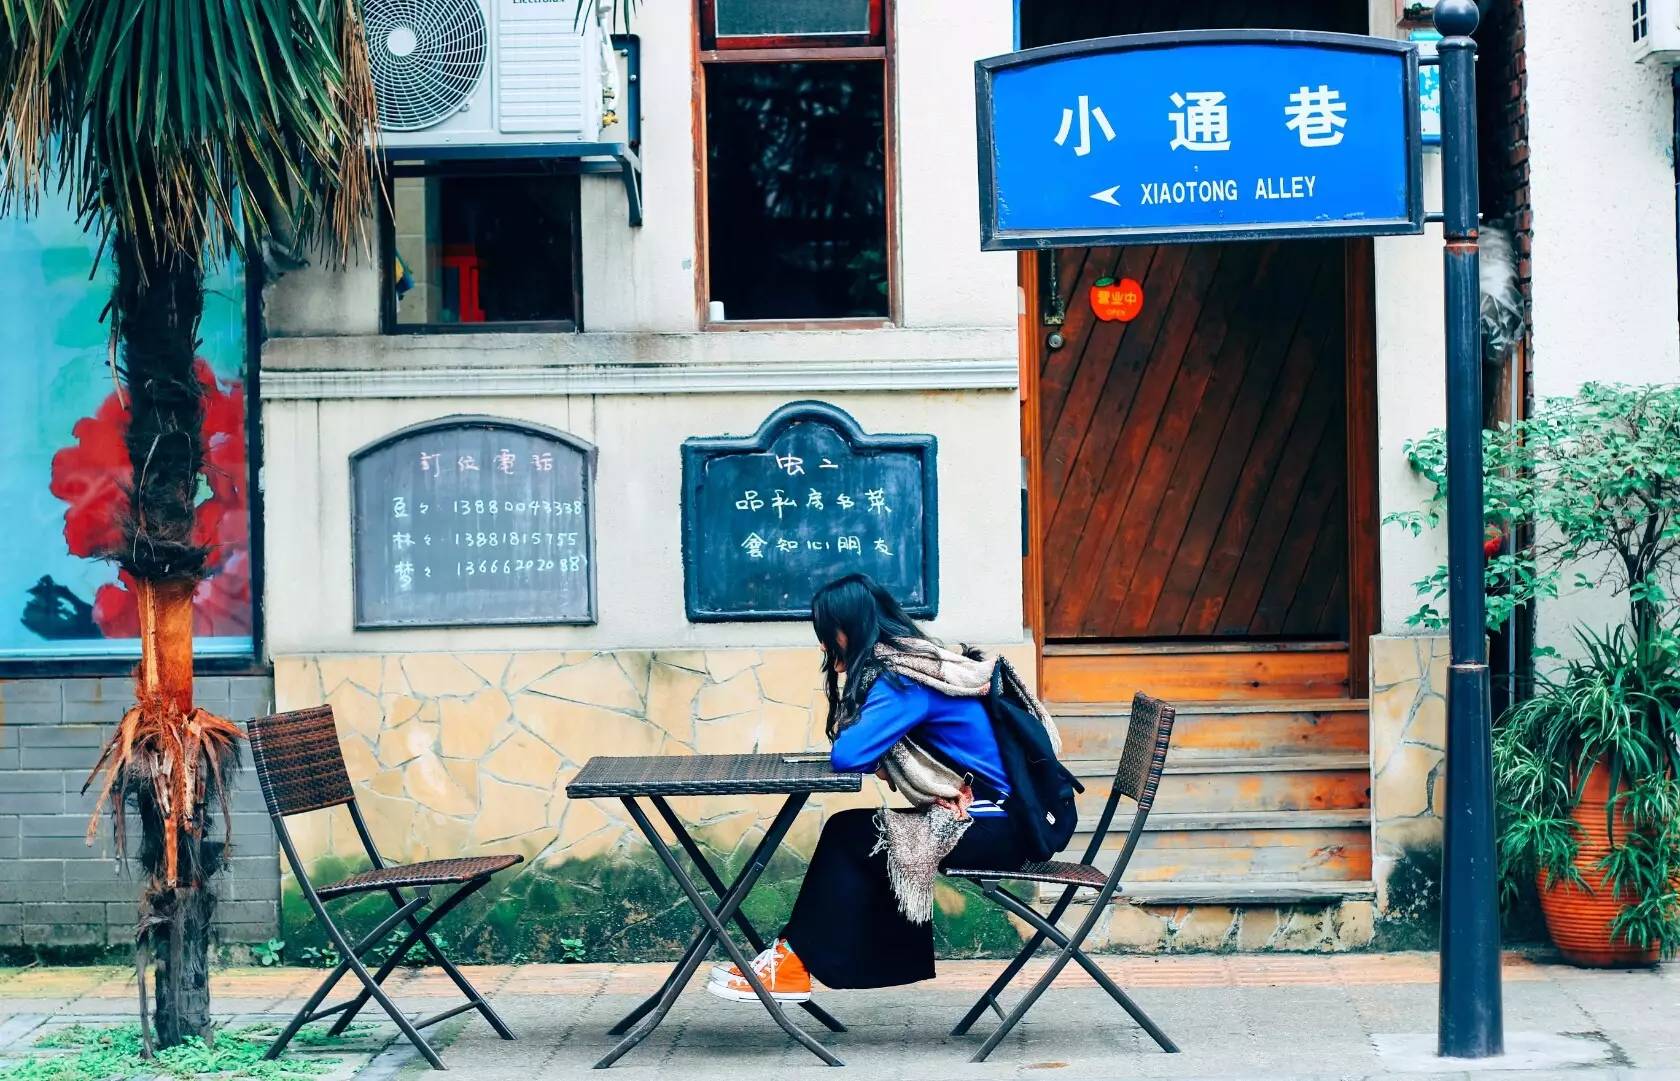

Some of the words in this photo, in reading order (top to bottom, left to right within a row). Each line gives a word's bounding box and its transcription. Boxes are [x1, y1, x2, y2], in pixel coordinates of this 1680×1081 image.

[1053, 84, 1348, 157] 小通巷
[1140, 179, 1239, 206] XIAOTONG
[1254, 175, 1317, 200] ALLEY
[735, 487, 892, 520] 品私房名菜
[455, 531, 579, 548] 13881815755
